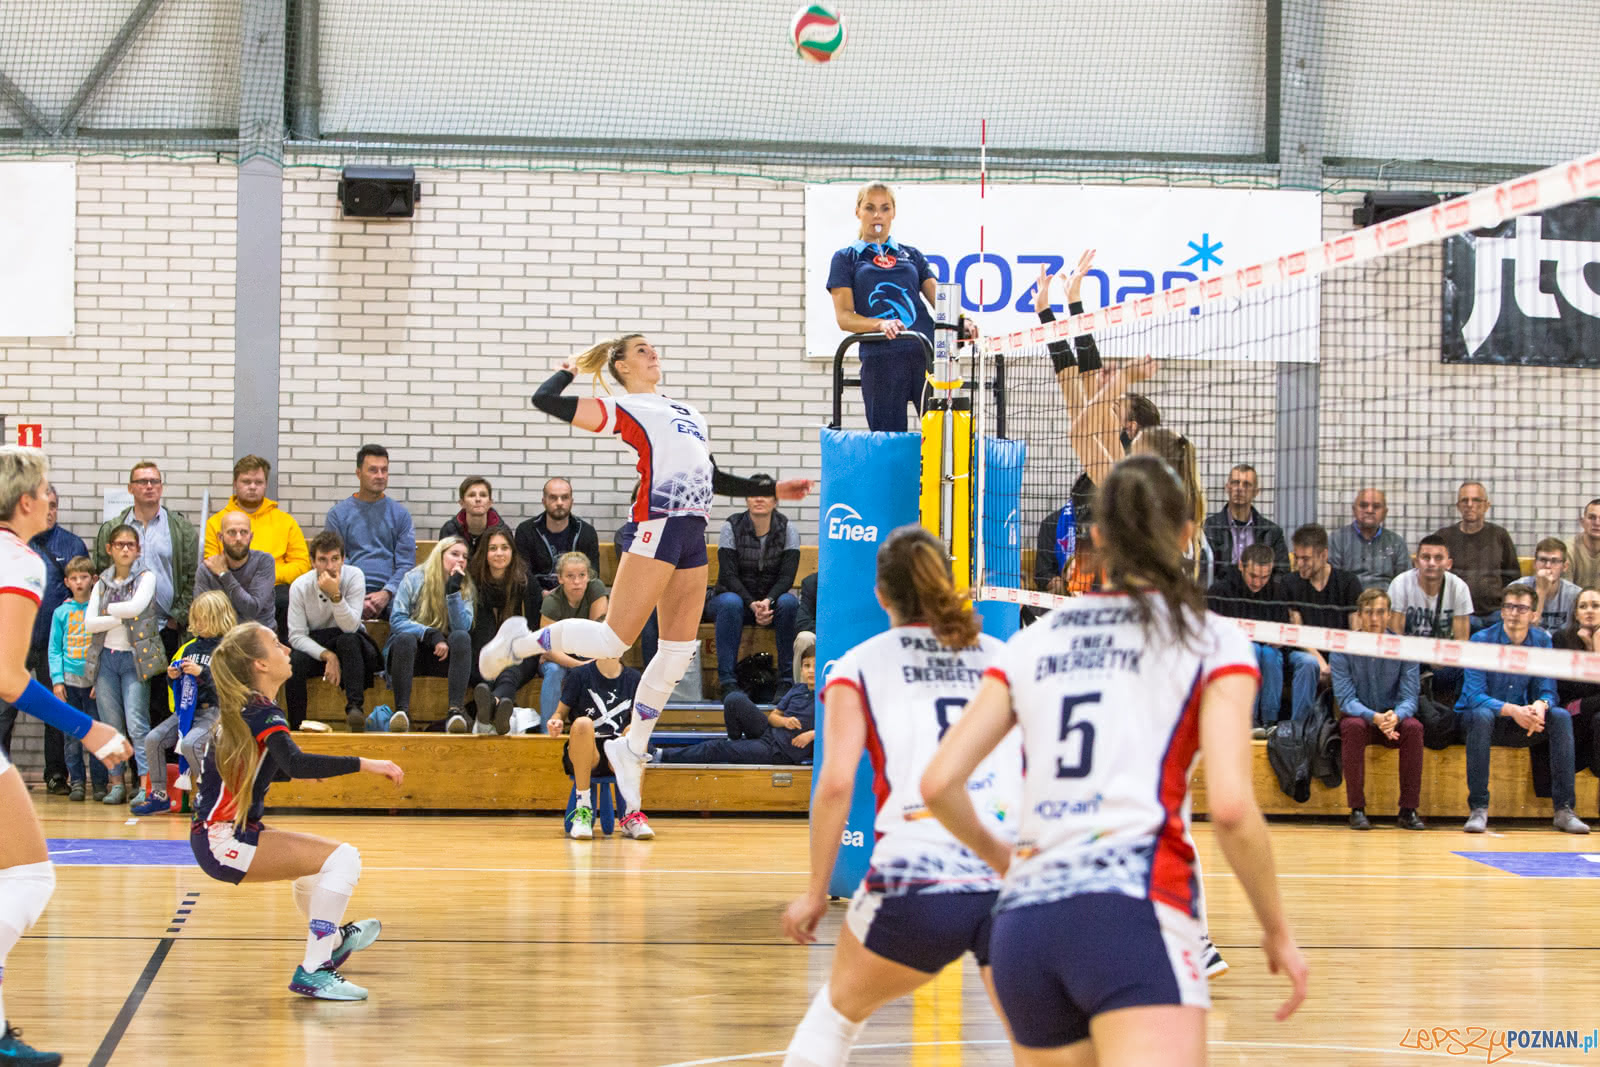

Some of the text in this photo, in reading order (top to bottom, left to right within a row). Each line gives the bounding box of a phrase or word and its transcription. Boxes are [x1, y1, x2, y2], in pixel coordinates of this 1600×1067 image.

[828, 517, 878, 542] Enea
[1071, 633, 1113, 650] ENEA
[926, 656, 966, 668] ENEA
[902, 665, 984, 684] ENERGETY
[1055, 691, 1103, 778] 5
[841, 829, 865, 848] ea
